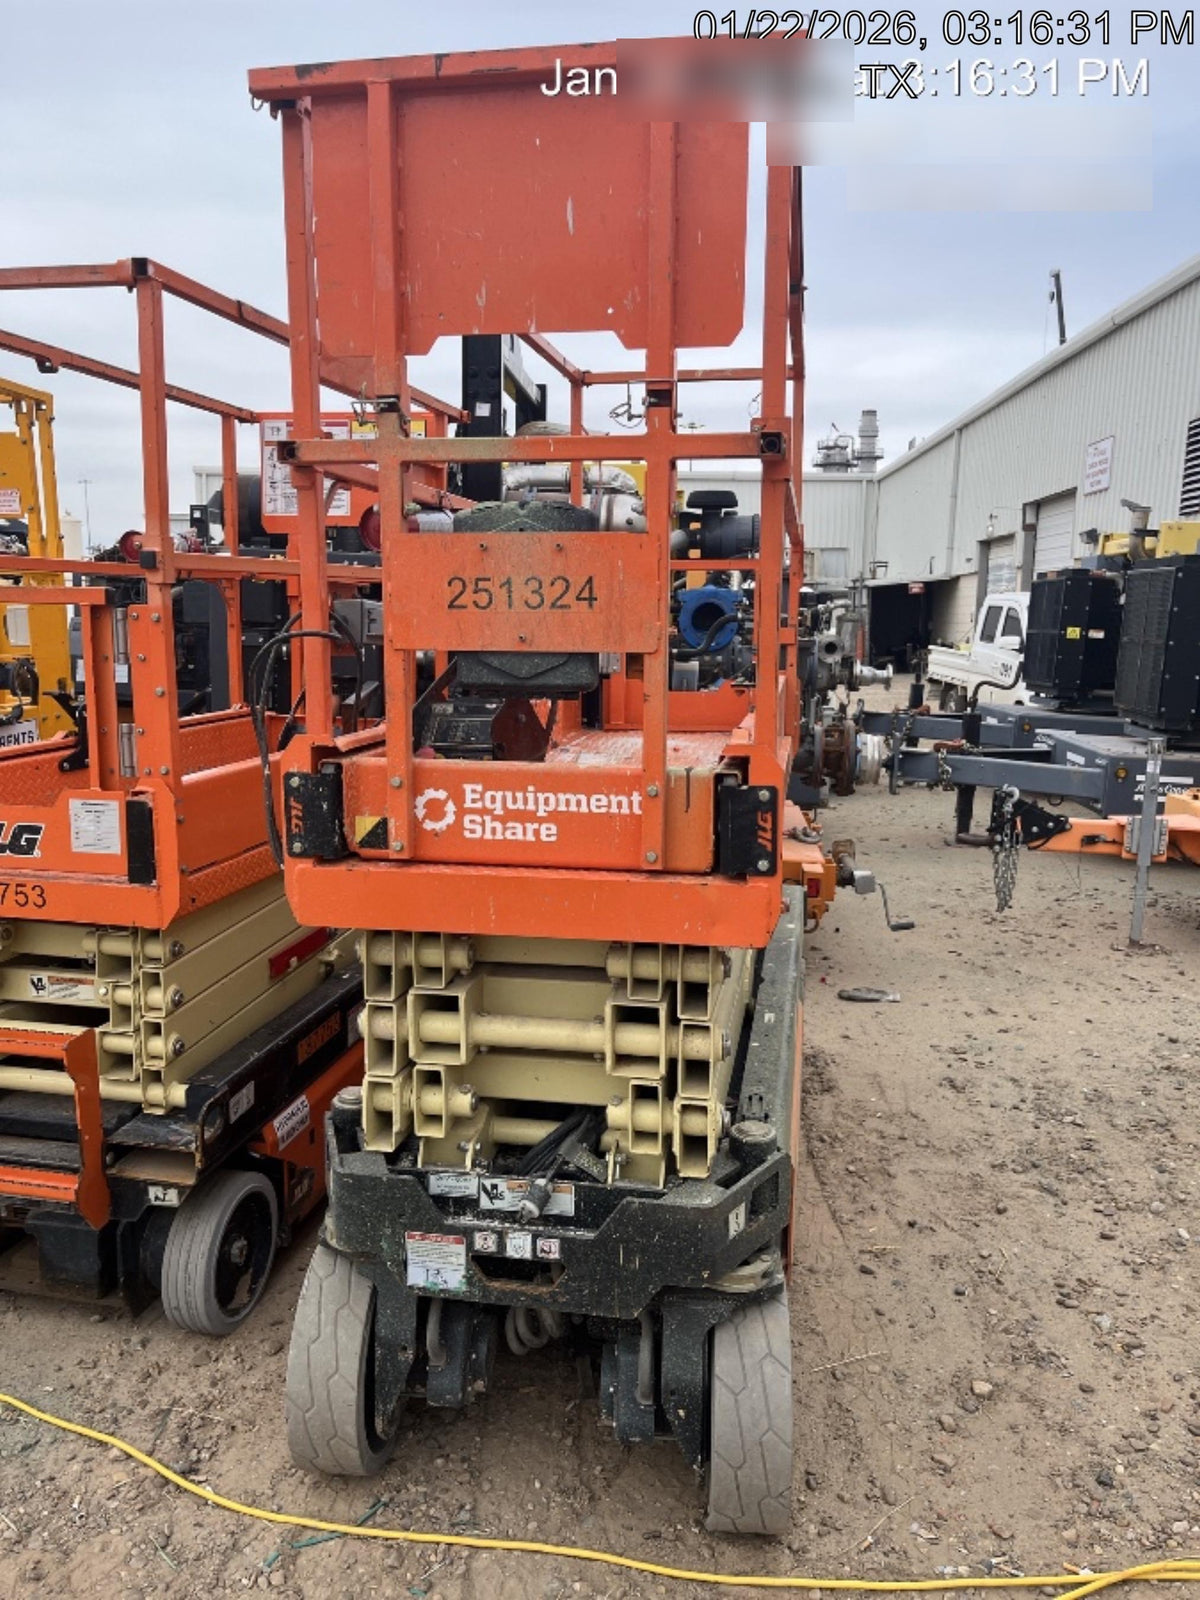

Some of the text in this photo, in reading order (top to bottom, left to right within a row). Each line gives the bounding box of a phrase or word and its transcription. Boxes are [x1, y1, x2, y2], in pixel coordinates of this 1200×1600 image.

[447, 576, 598, 610] 251324
[462, 783, 643, 817] Equipment
[463, 814, 558, 842] Share
[757, 810, 773, 852] JLG
